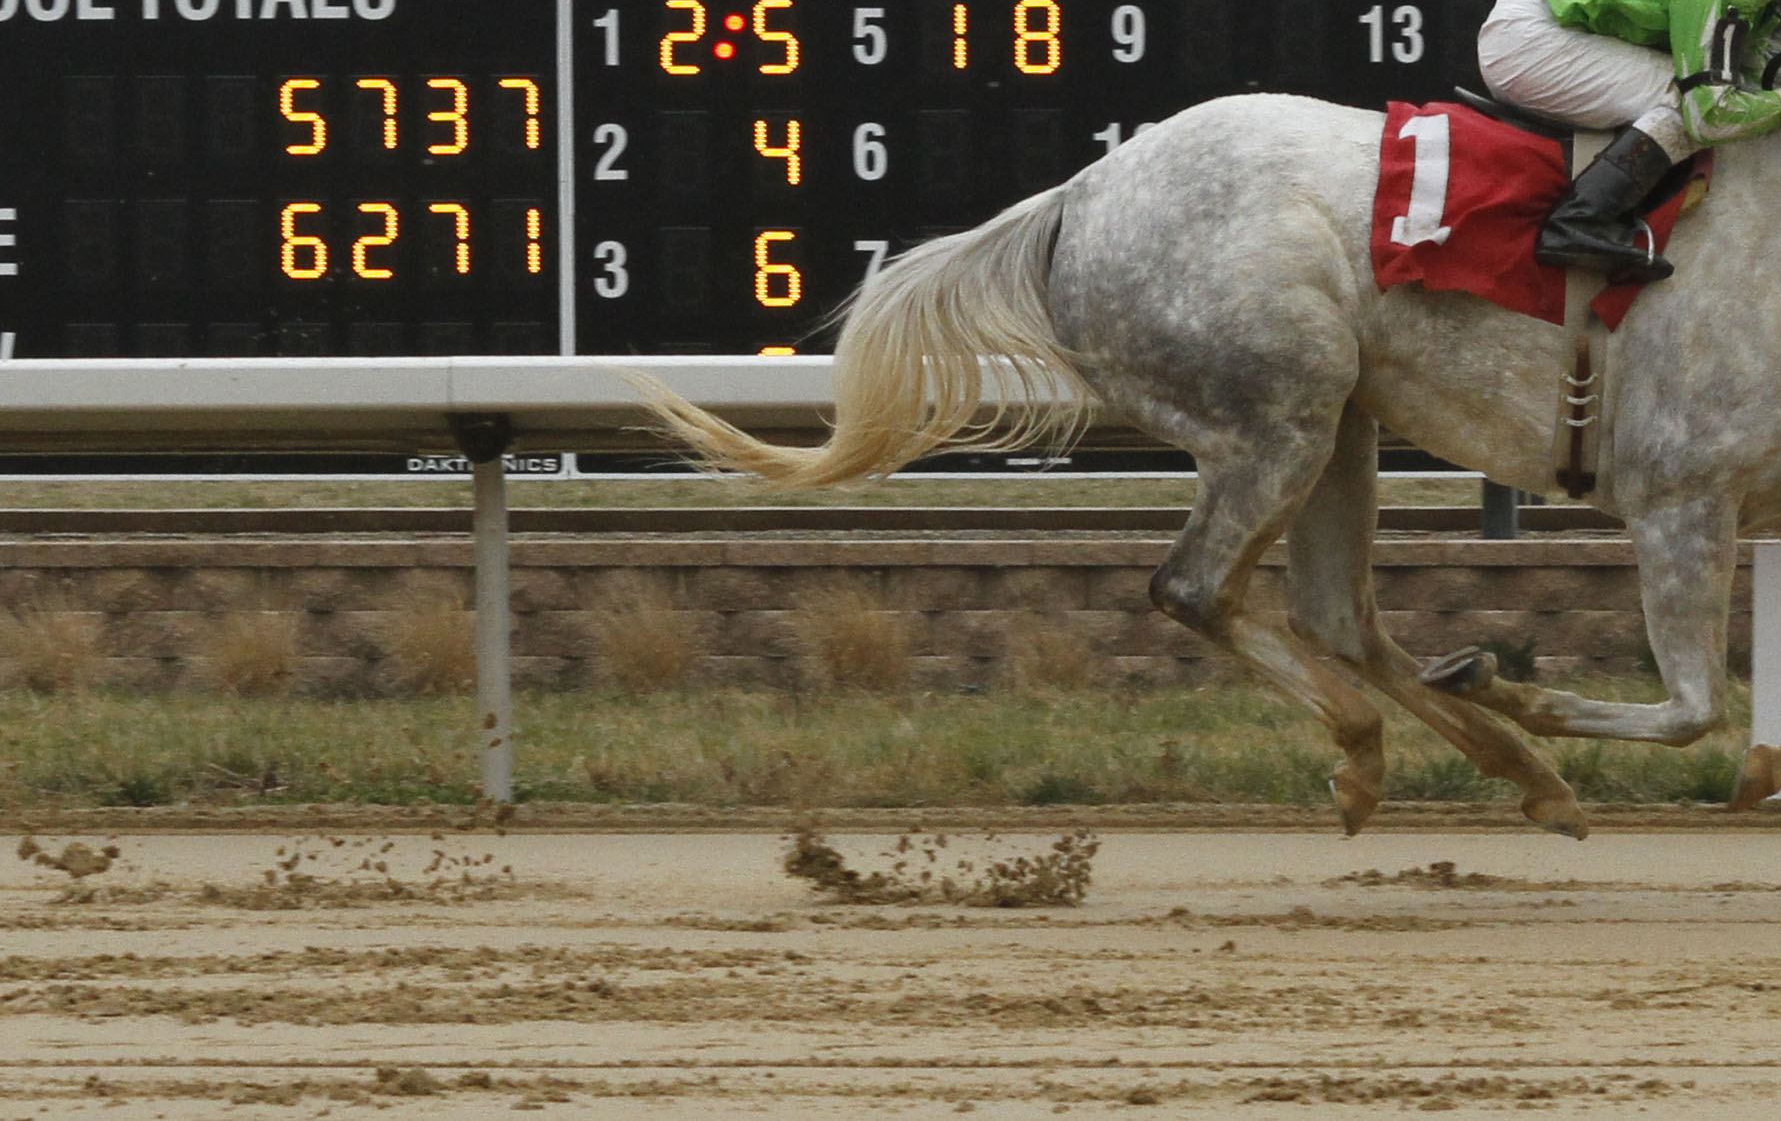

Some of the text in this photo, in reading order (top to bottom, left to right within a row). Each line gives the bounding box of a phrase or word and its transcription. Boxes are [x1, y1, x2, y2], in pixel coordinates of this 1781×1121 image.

[593, 9, 620, 66] 1
[853, 7, 887, 65] 5
[1111, 4, 1146, 63] 9
[1358, 4, 1424, 64] 13
[279, 77, 541, 156] 5737
[593, 123, 628, 181] 2
[753, 119, 802, 186] 4
[853, 122, 888, 181] 6
[1390, 113, 1451, 247] 1
[280, 201, 542, 280] 6271
[593, 240, 629, 299] 3
[754, 229, 802, 308] 6
[407, 457, 558, 471] DAKTNICS
